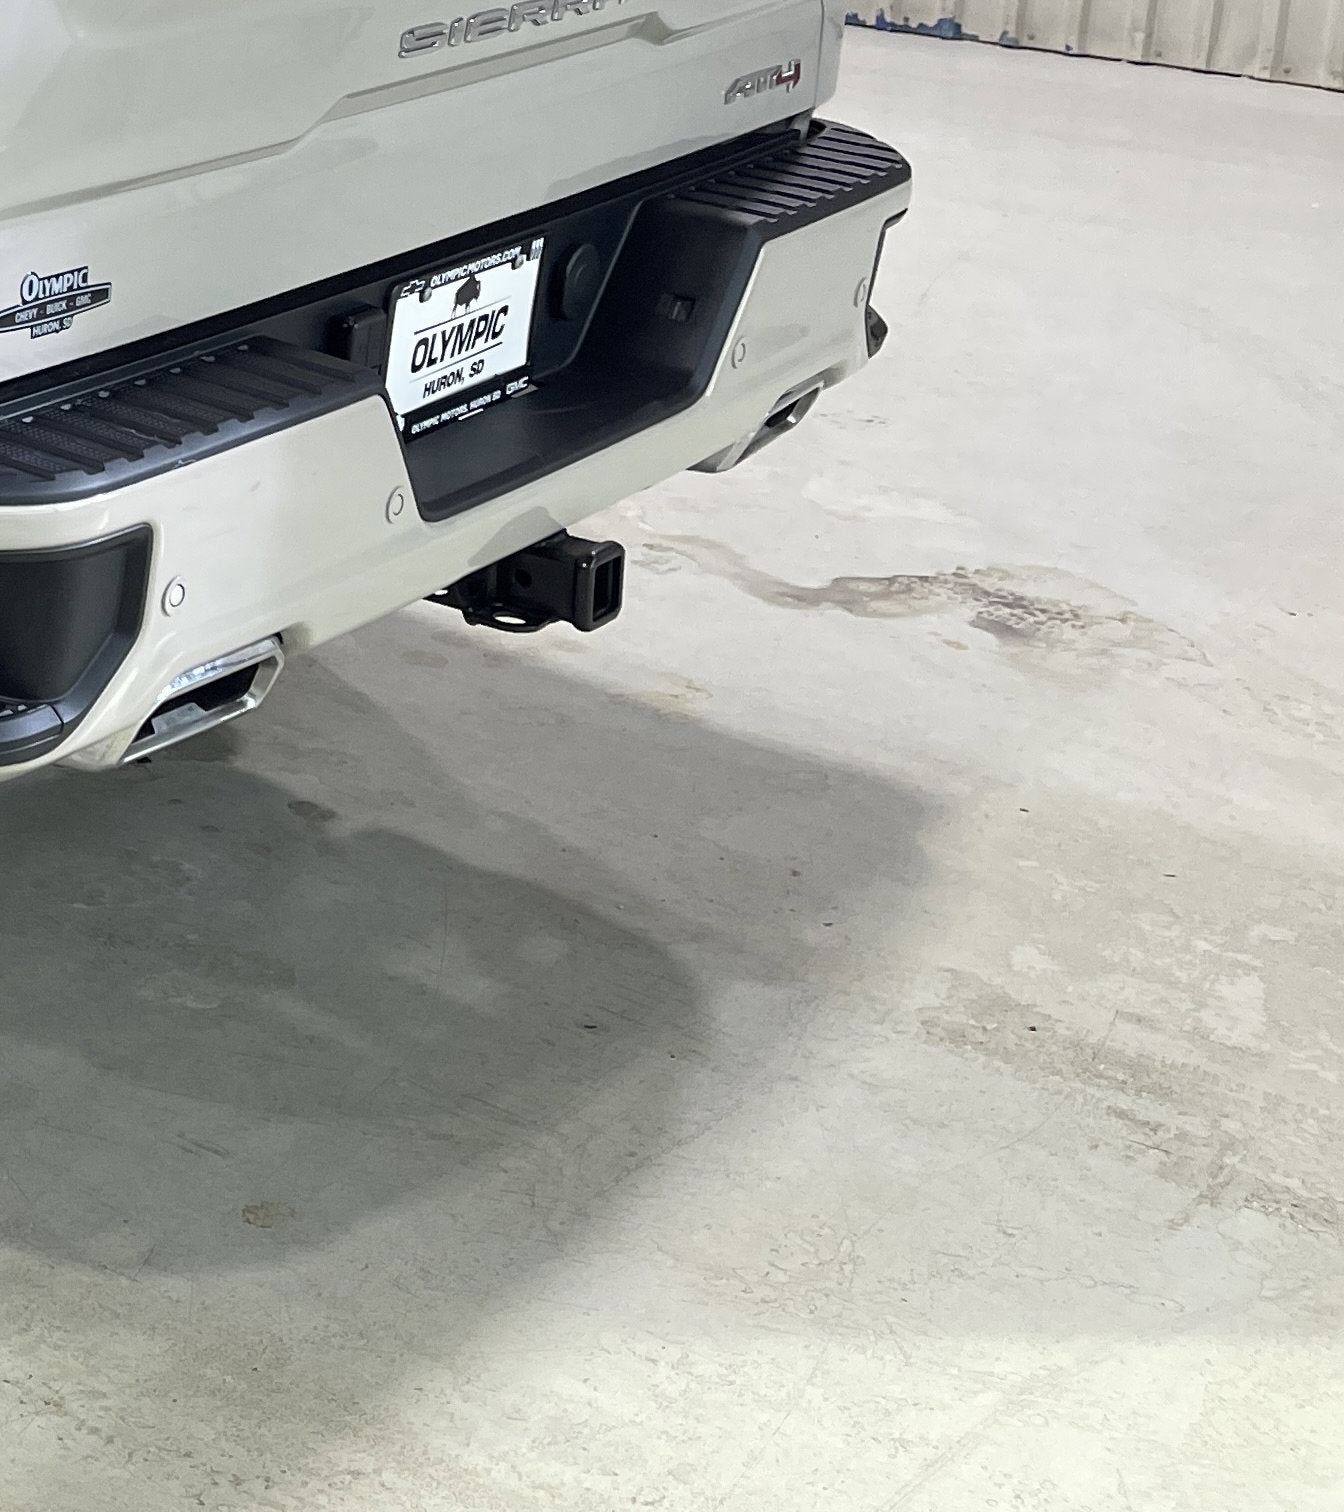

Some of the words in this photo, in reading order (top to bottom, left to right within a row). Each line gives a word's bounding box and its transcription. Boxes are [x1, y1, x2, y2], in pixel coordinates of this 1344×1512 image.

[723, 59, 801, 105] AT4
[22, 269, 88, 302] OLYMPIC
[410, 305, 508, 373] OLYMPIC
[422, 369, 464, 399] HURON,
[469, 359, 485, 378] SD
